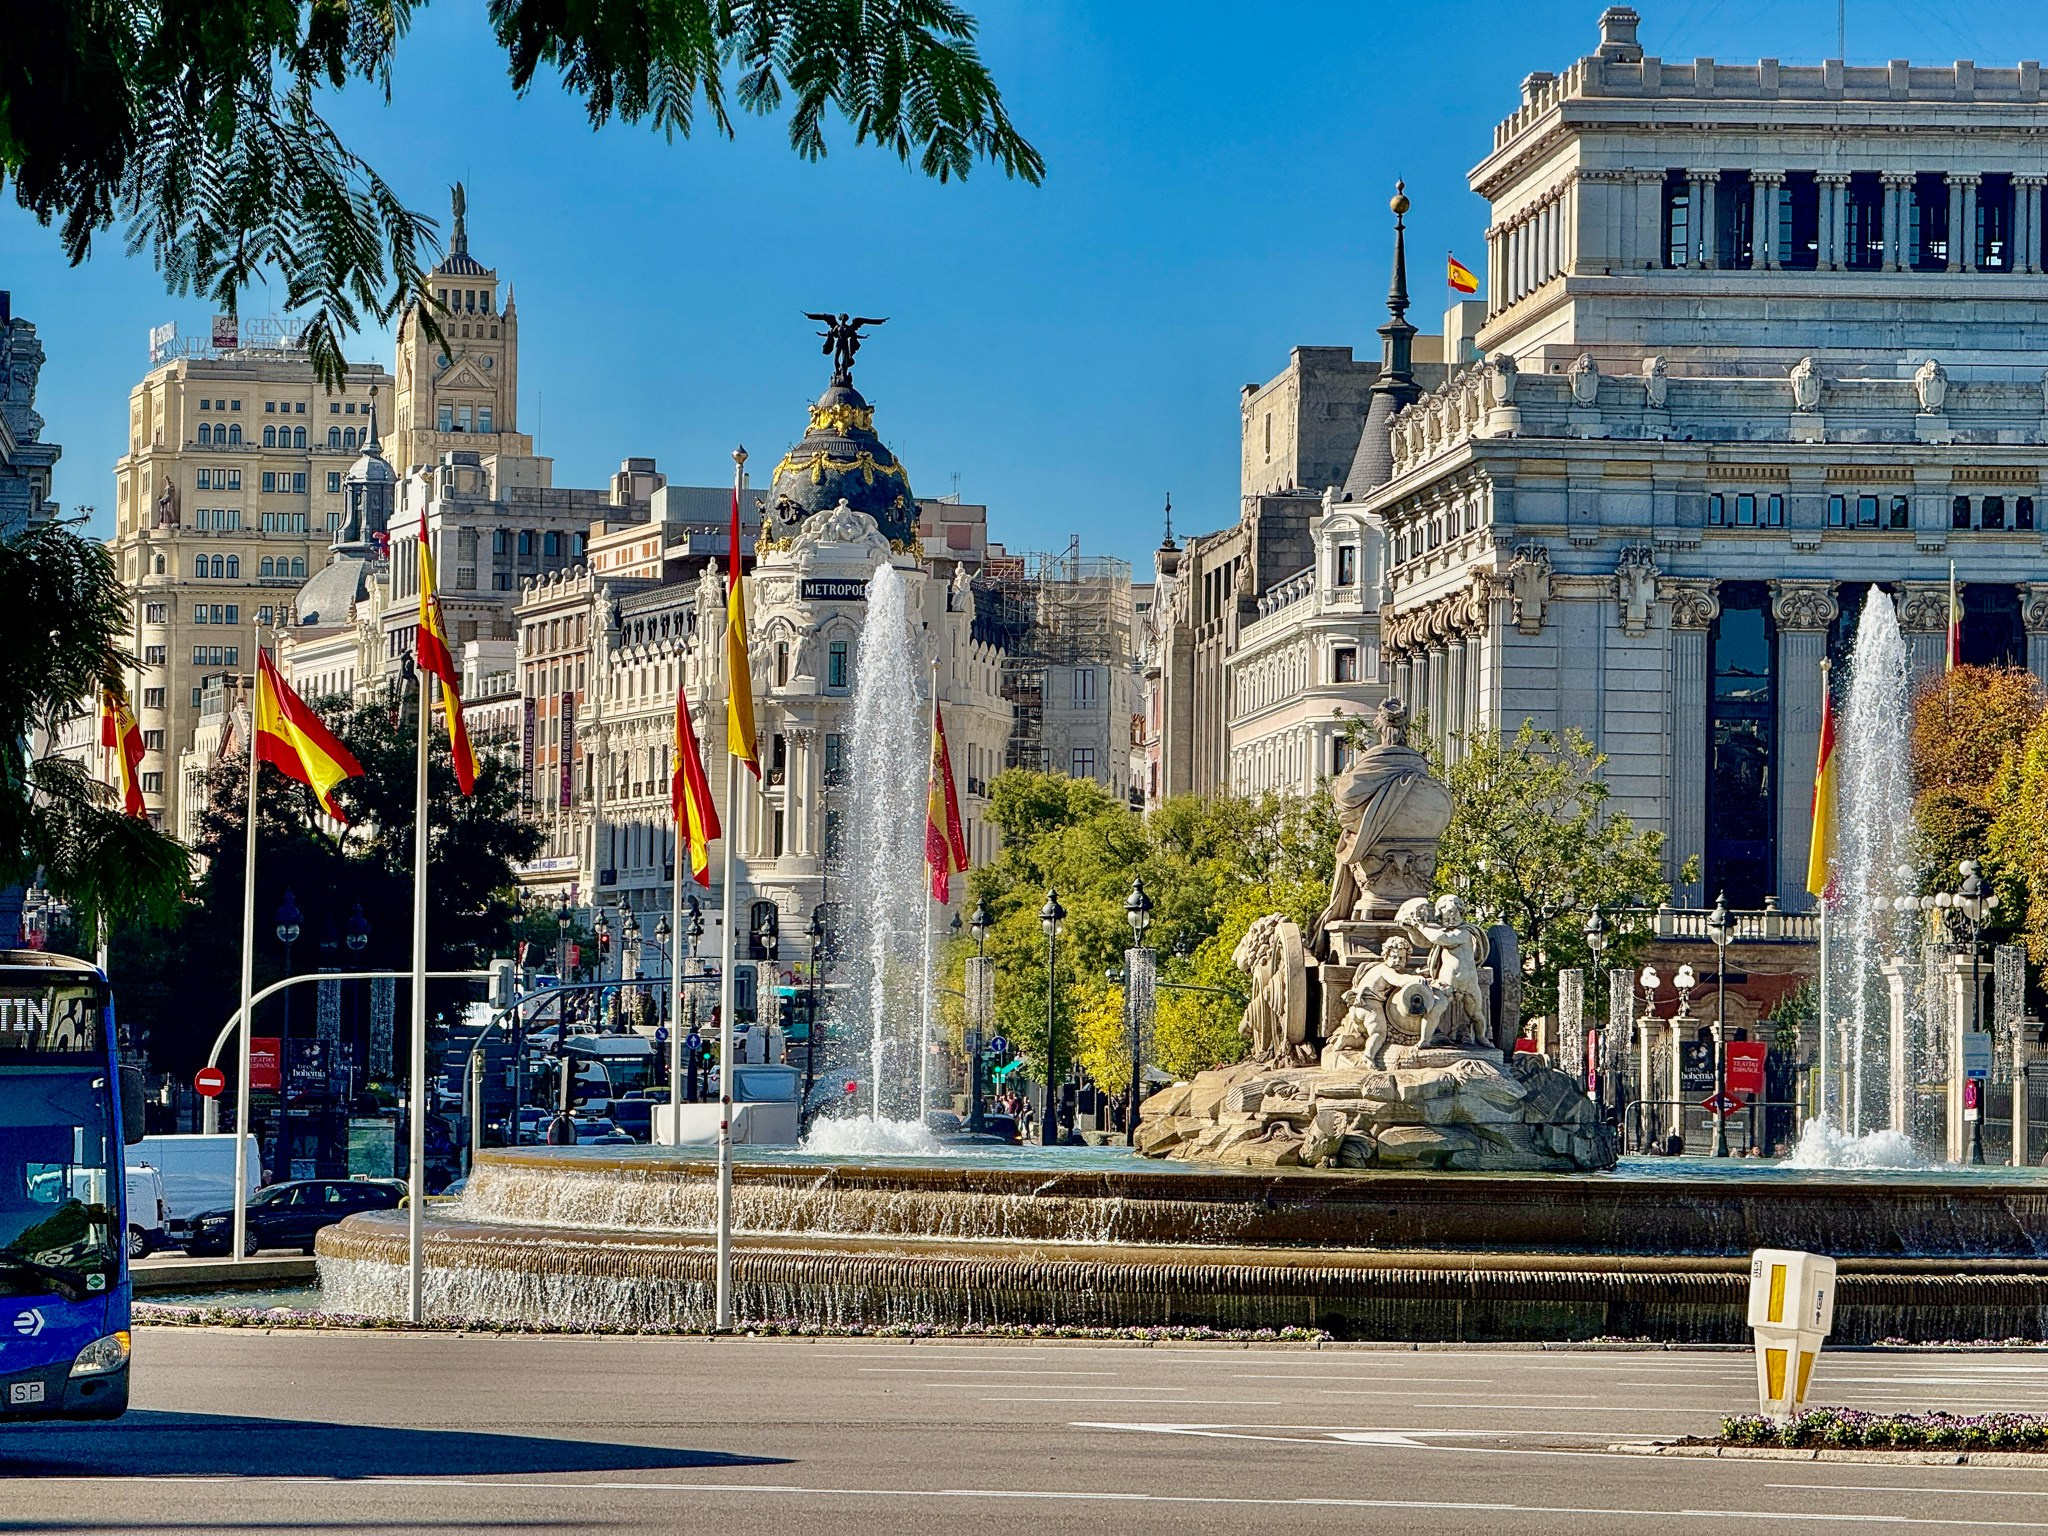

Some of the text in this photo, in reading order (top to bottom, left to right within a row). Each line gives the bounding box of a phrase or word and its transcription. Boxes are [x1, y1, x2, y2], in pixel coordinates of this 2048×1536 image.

[562, 703, 572, 763] NOS QUEREMOS VIVAS
[525, 726, 533, 771] MUJERES
[292, 1069, 326, 1078] bohemia
[1681, 1072, 1714, 1080] bohemia
